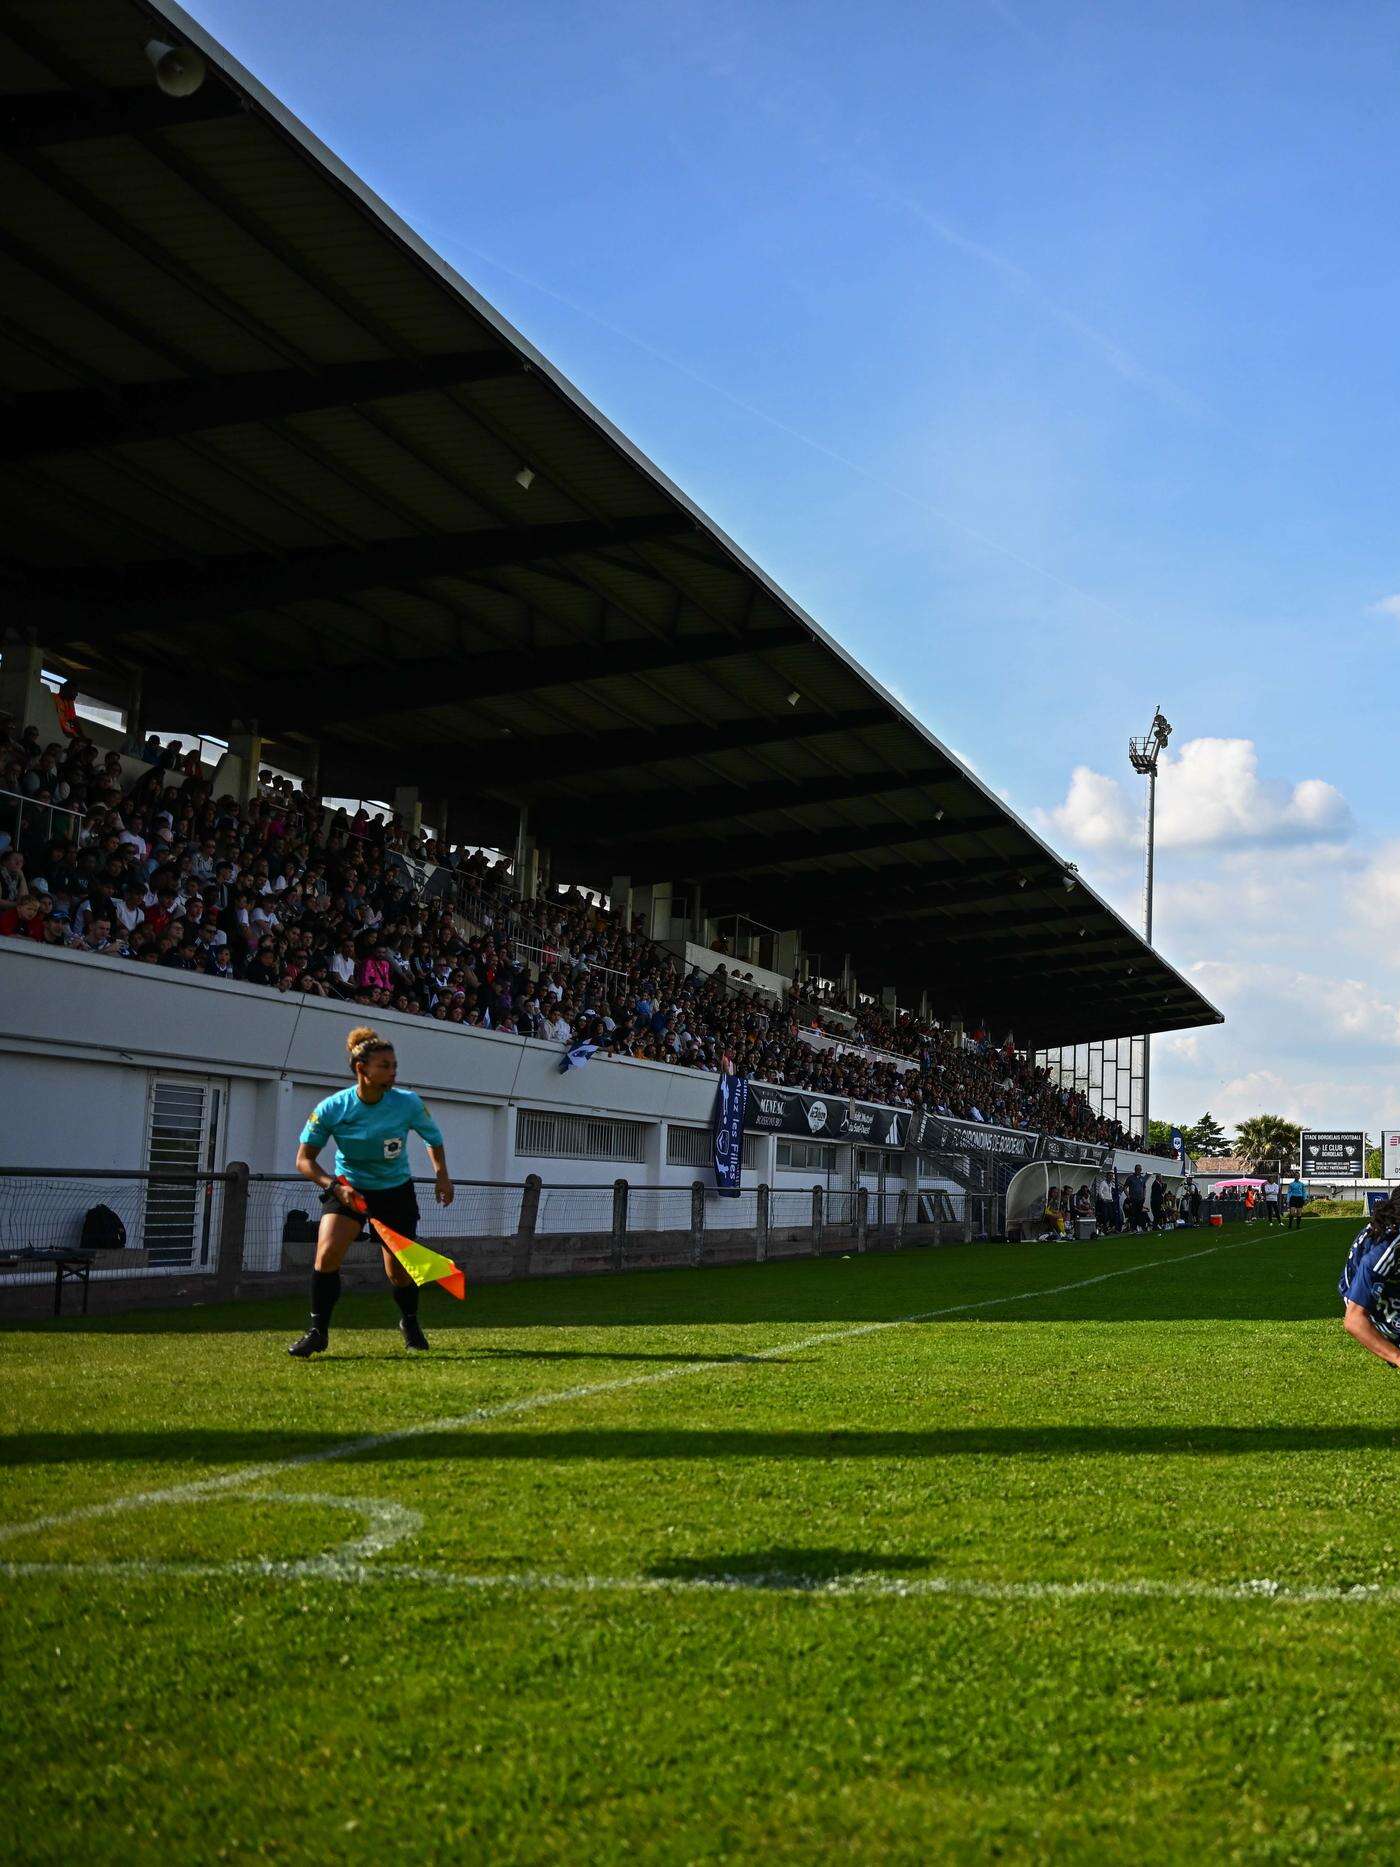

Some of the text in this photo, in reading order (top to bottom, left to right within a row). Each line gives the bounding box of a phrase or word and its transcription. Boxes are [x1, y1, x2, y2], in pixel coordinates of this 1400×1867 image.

[729, 1077, 742, 1180] Allez les Filles
